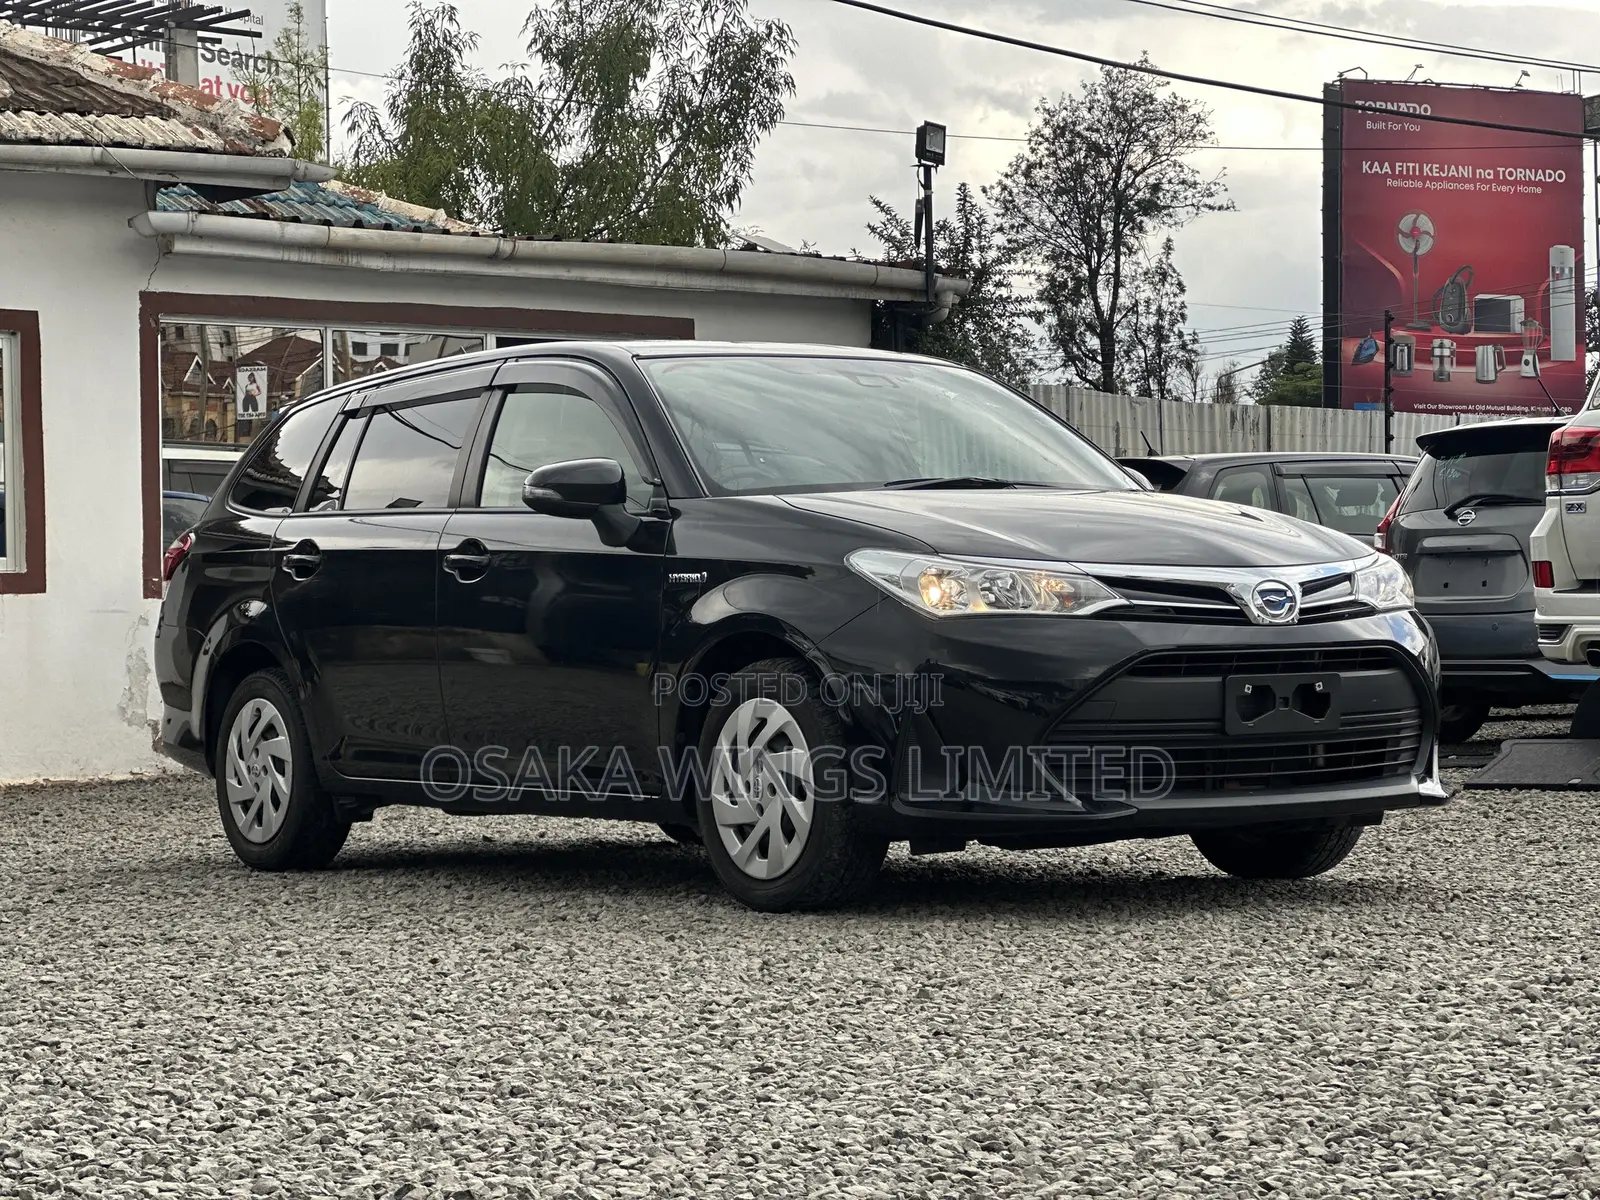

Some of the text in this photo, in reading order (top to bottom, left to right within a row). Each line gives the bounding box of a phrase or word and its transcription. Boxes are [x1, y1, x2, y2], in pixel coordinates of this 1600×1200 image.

[200, 42, 280, 77] Search
[200, 75, 222, 97] at
[1355, 100, 1432, 116] TORNADO
[1366, 120, 1421, 132] Built For You
[1362, 160, 1566, 183] KAA FITI KEJANI na TORNADO
[1386, 178, 1542, 194] Reliable Appliances For Every Home
[1566, 503, 1584, 511] ZX
[668, 573, 701, 583] HYBRID
